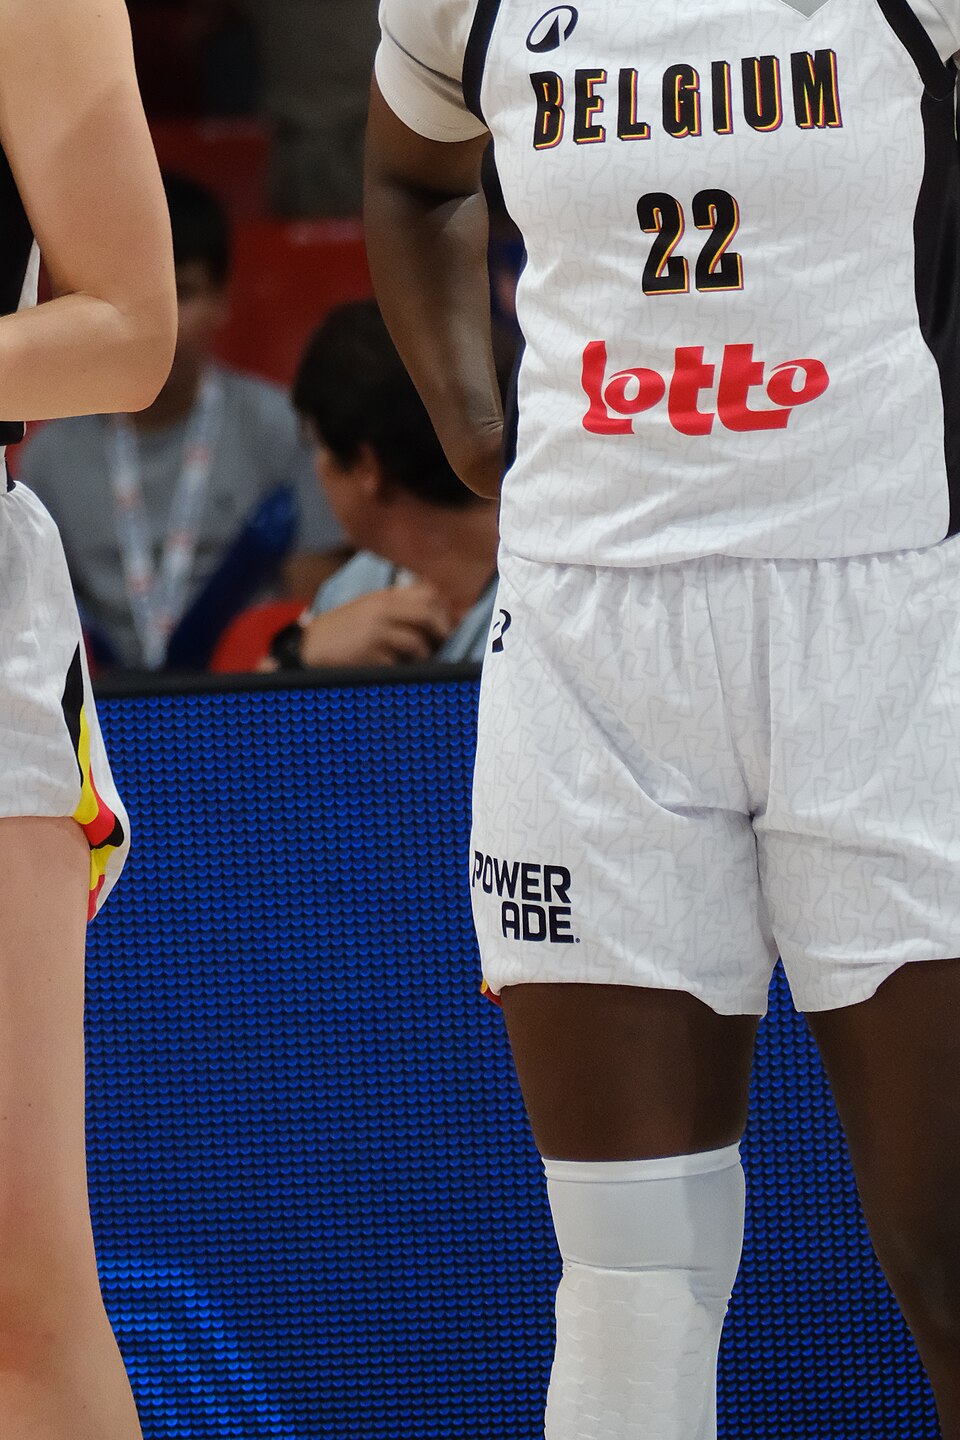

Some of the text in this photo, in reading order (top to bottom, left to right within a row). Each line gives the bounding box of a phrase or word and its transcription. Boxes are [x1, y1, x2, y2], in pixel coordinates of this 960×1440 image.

[529, 49, 843, 150] BELGIUM
[636, 188, 744, 296] 22
[472, 850, 572, 903] POWER
